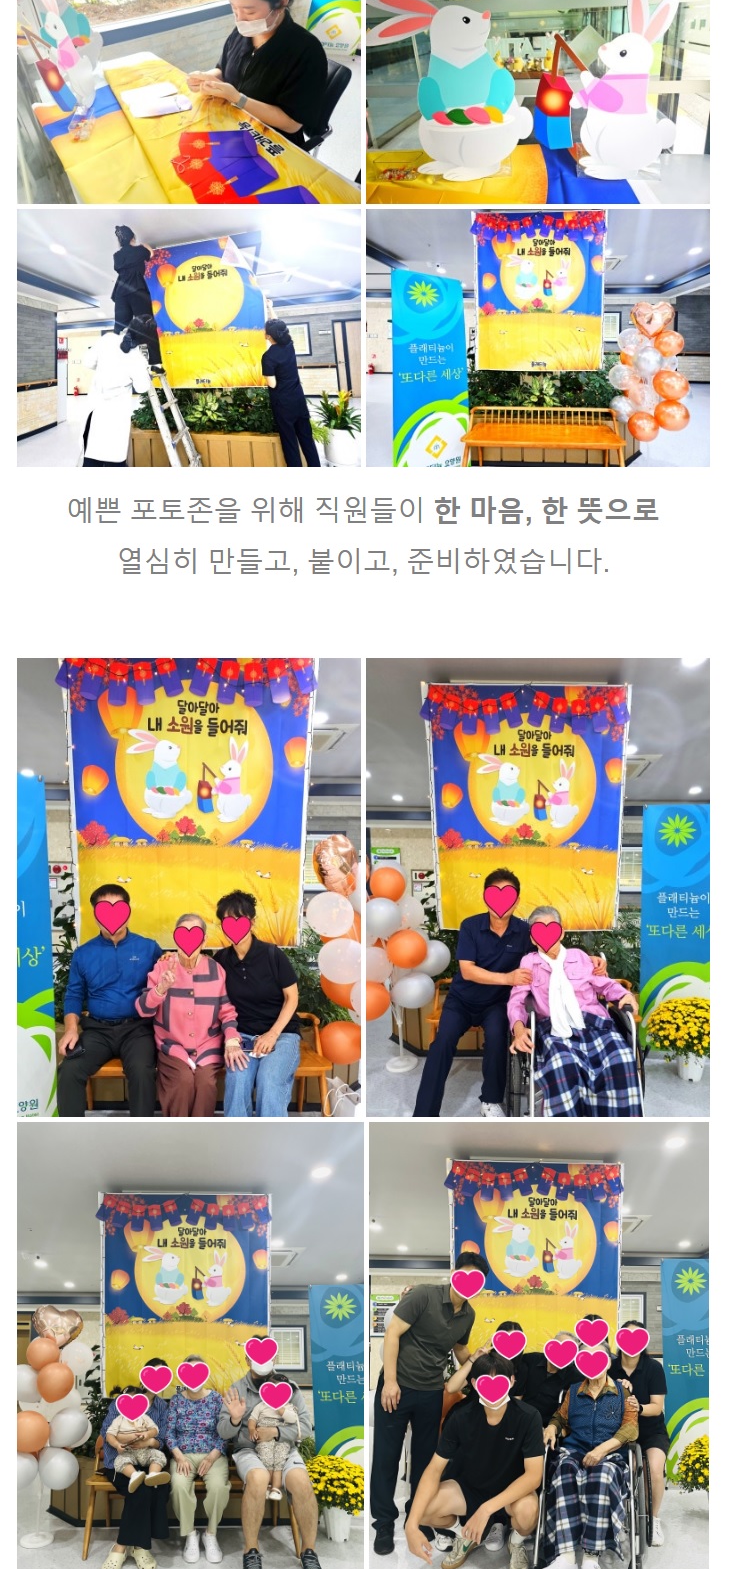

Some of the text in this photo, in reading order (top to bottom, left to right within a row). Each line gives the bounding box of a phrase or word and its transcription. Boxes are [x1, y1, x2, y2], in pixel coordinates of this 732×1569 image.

[408, 343, 454, 354] 플래티늄이
[418, 356, 446, 366] 만드는
[177, 700, 220, 716] 달아달아
[147, 716, 248, 737] 내 소원을 들어줘
